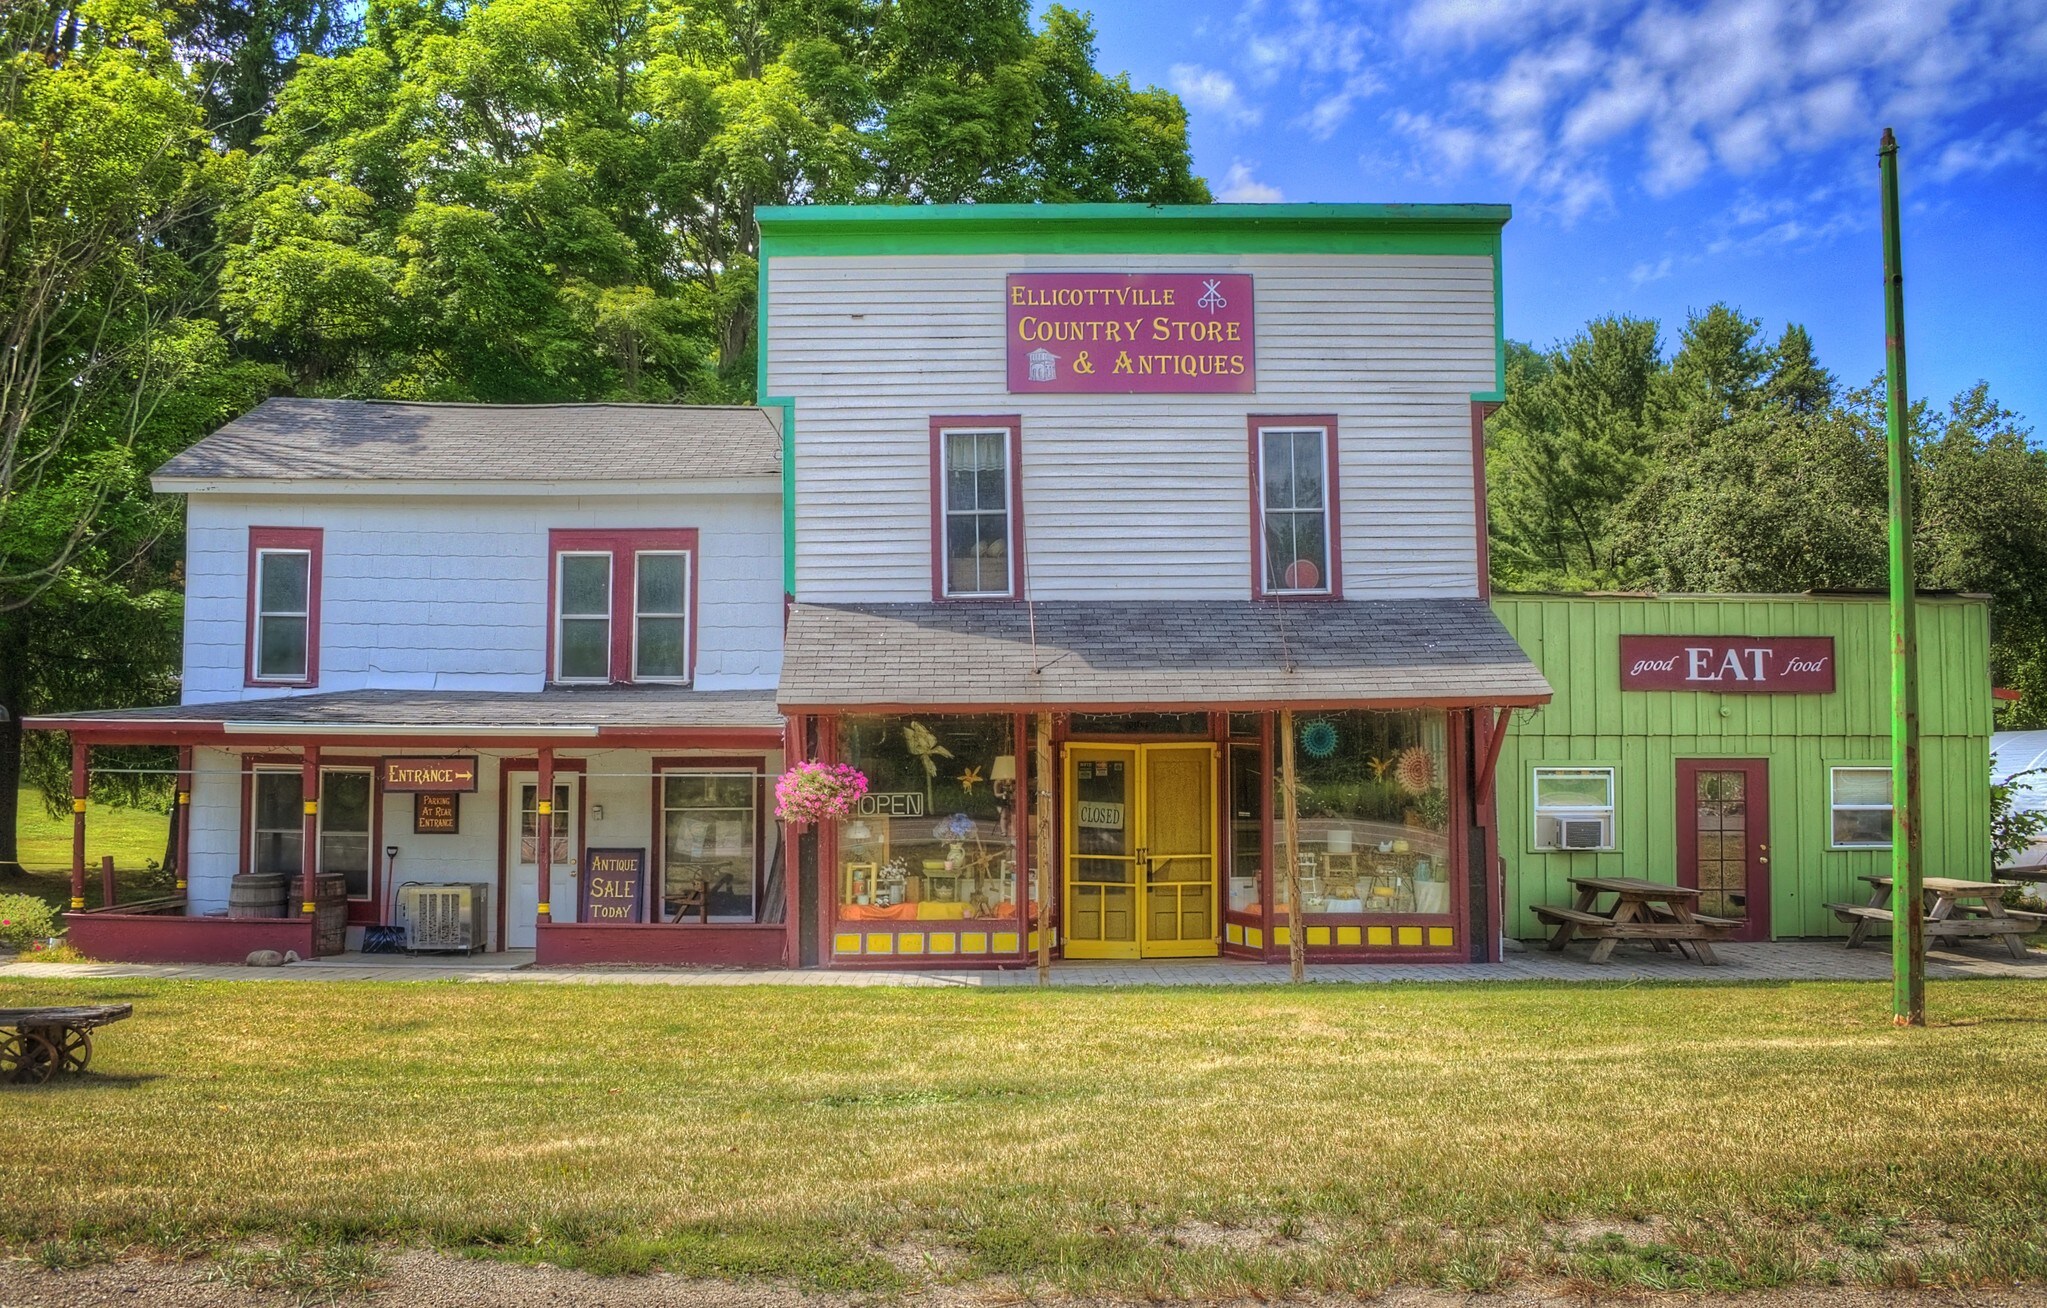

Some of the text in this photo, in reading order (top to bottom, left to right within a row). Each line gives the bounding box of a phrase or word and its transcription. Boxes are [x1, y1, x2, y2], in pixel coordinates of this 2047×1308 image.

[1010, 285, 1176, 306] ELLICOTTVILLE
[1018, 316, 1241, 343] COUNTRY STORE
[1072, 350, 1245, 377] & ANTIQUES
[1630, 647, 1828, 681] good EAT food
[388, 764, 454, 785] ENTRANCE
[423, 795, 451, 805] PARKING
[860, 794, 921, 815] OPEN
[422, 806, 452, 817] AT REAR
[1080, 806, 1120, 825] CLOSED
[419, 817, 454, 828] ENTRANCE
[592, 856, 638, 872] ANTIQUE
[590, 877, 636, 898] SALE
[590, 904, 633, 918] TODAY
